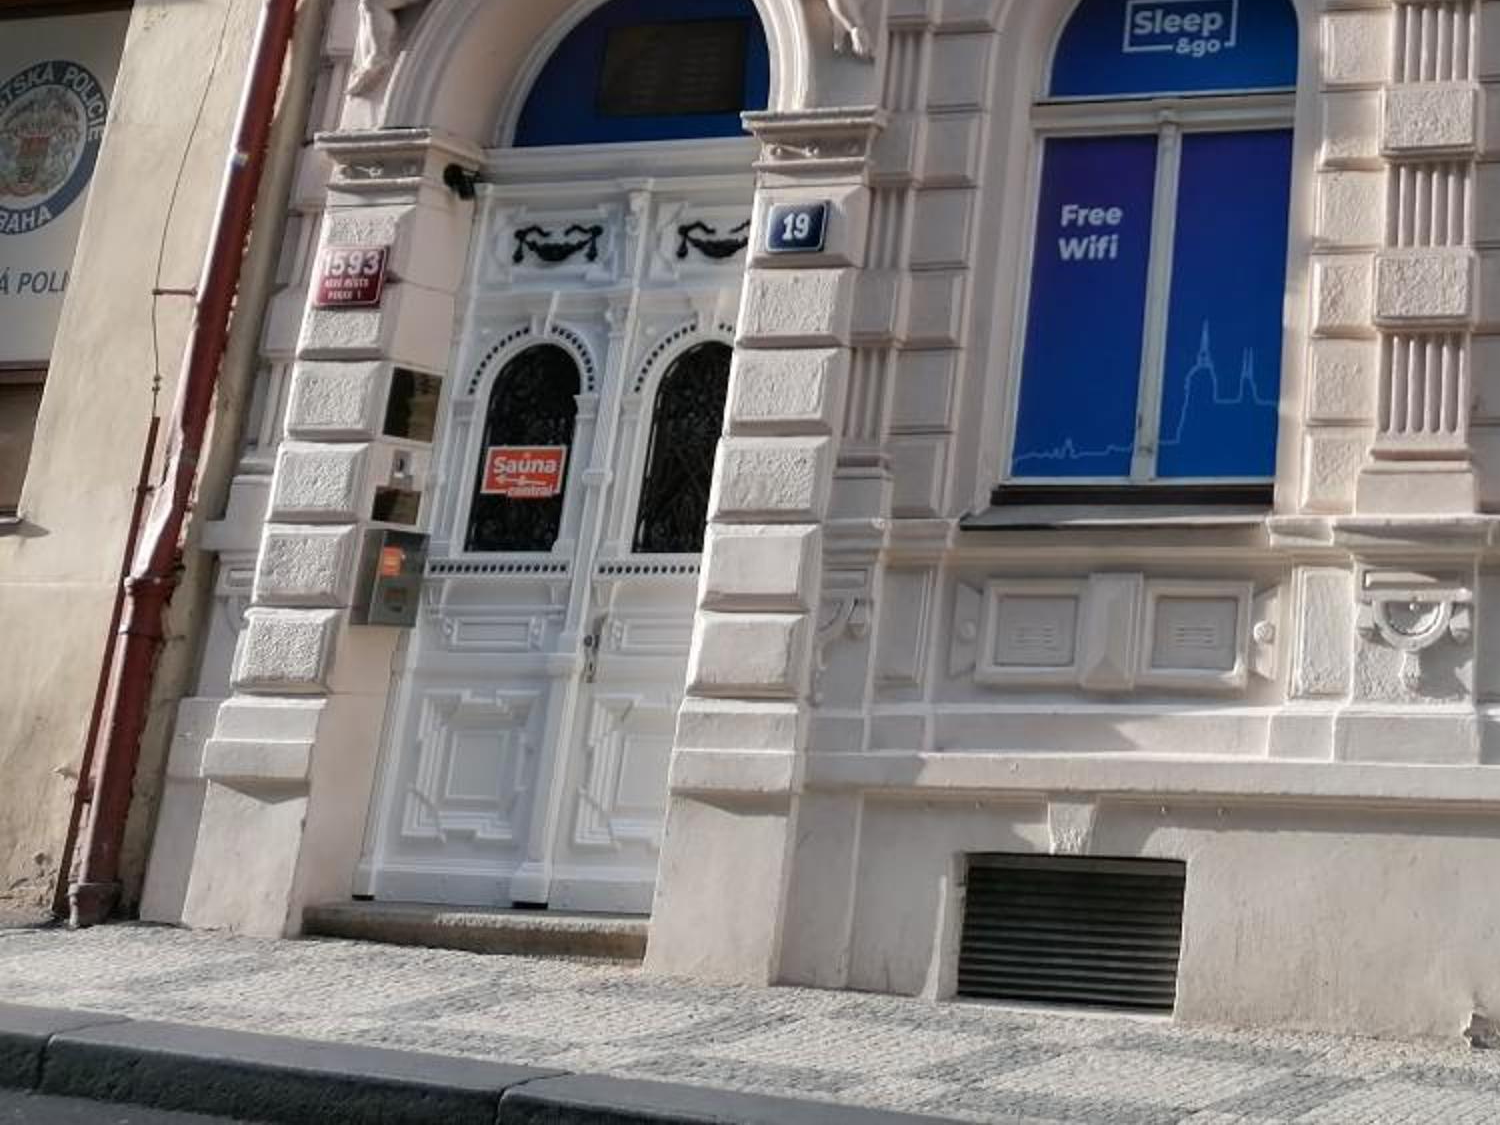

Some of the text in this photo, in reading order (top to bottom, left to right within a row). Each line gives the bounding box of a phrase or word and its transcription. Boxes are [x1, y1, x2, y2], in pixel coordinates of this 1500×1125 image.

[1133, 8, 1223, 37] Sleep
[1175, 37, 1220, 58] &go
[0, 62, 106, 141] TSKÁ POLICIE
[782, 212, 810, 241] 19
[1061, 204, 1123, 227] Free
[1058, 234, 1119, 261] Wifi
[493, 456, 557, 474] Sauna
